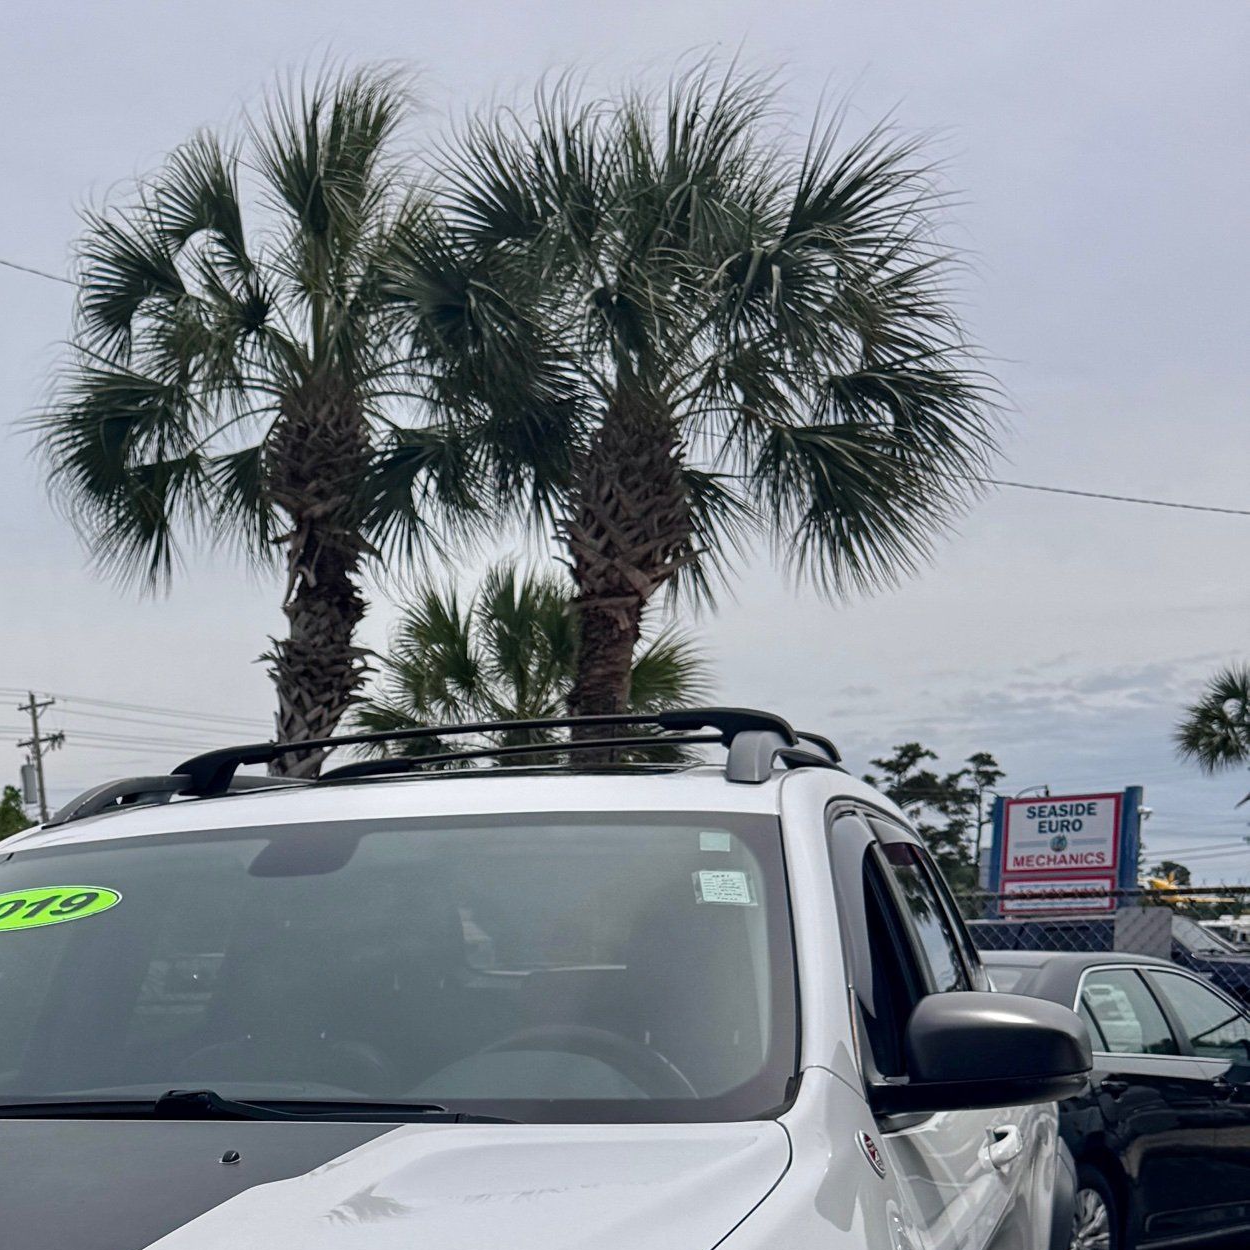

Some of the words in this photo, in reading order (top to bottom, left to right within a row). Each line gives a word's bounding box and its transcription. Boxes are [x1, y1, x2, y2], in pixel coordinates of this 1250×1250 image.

[1026, 802, 1098, 819] SEASIDE
[1038, 818, 1083, 834] EURO
[1013, 851, 1106, 867] MECHANICS
